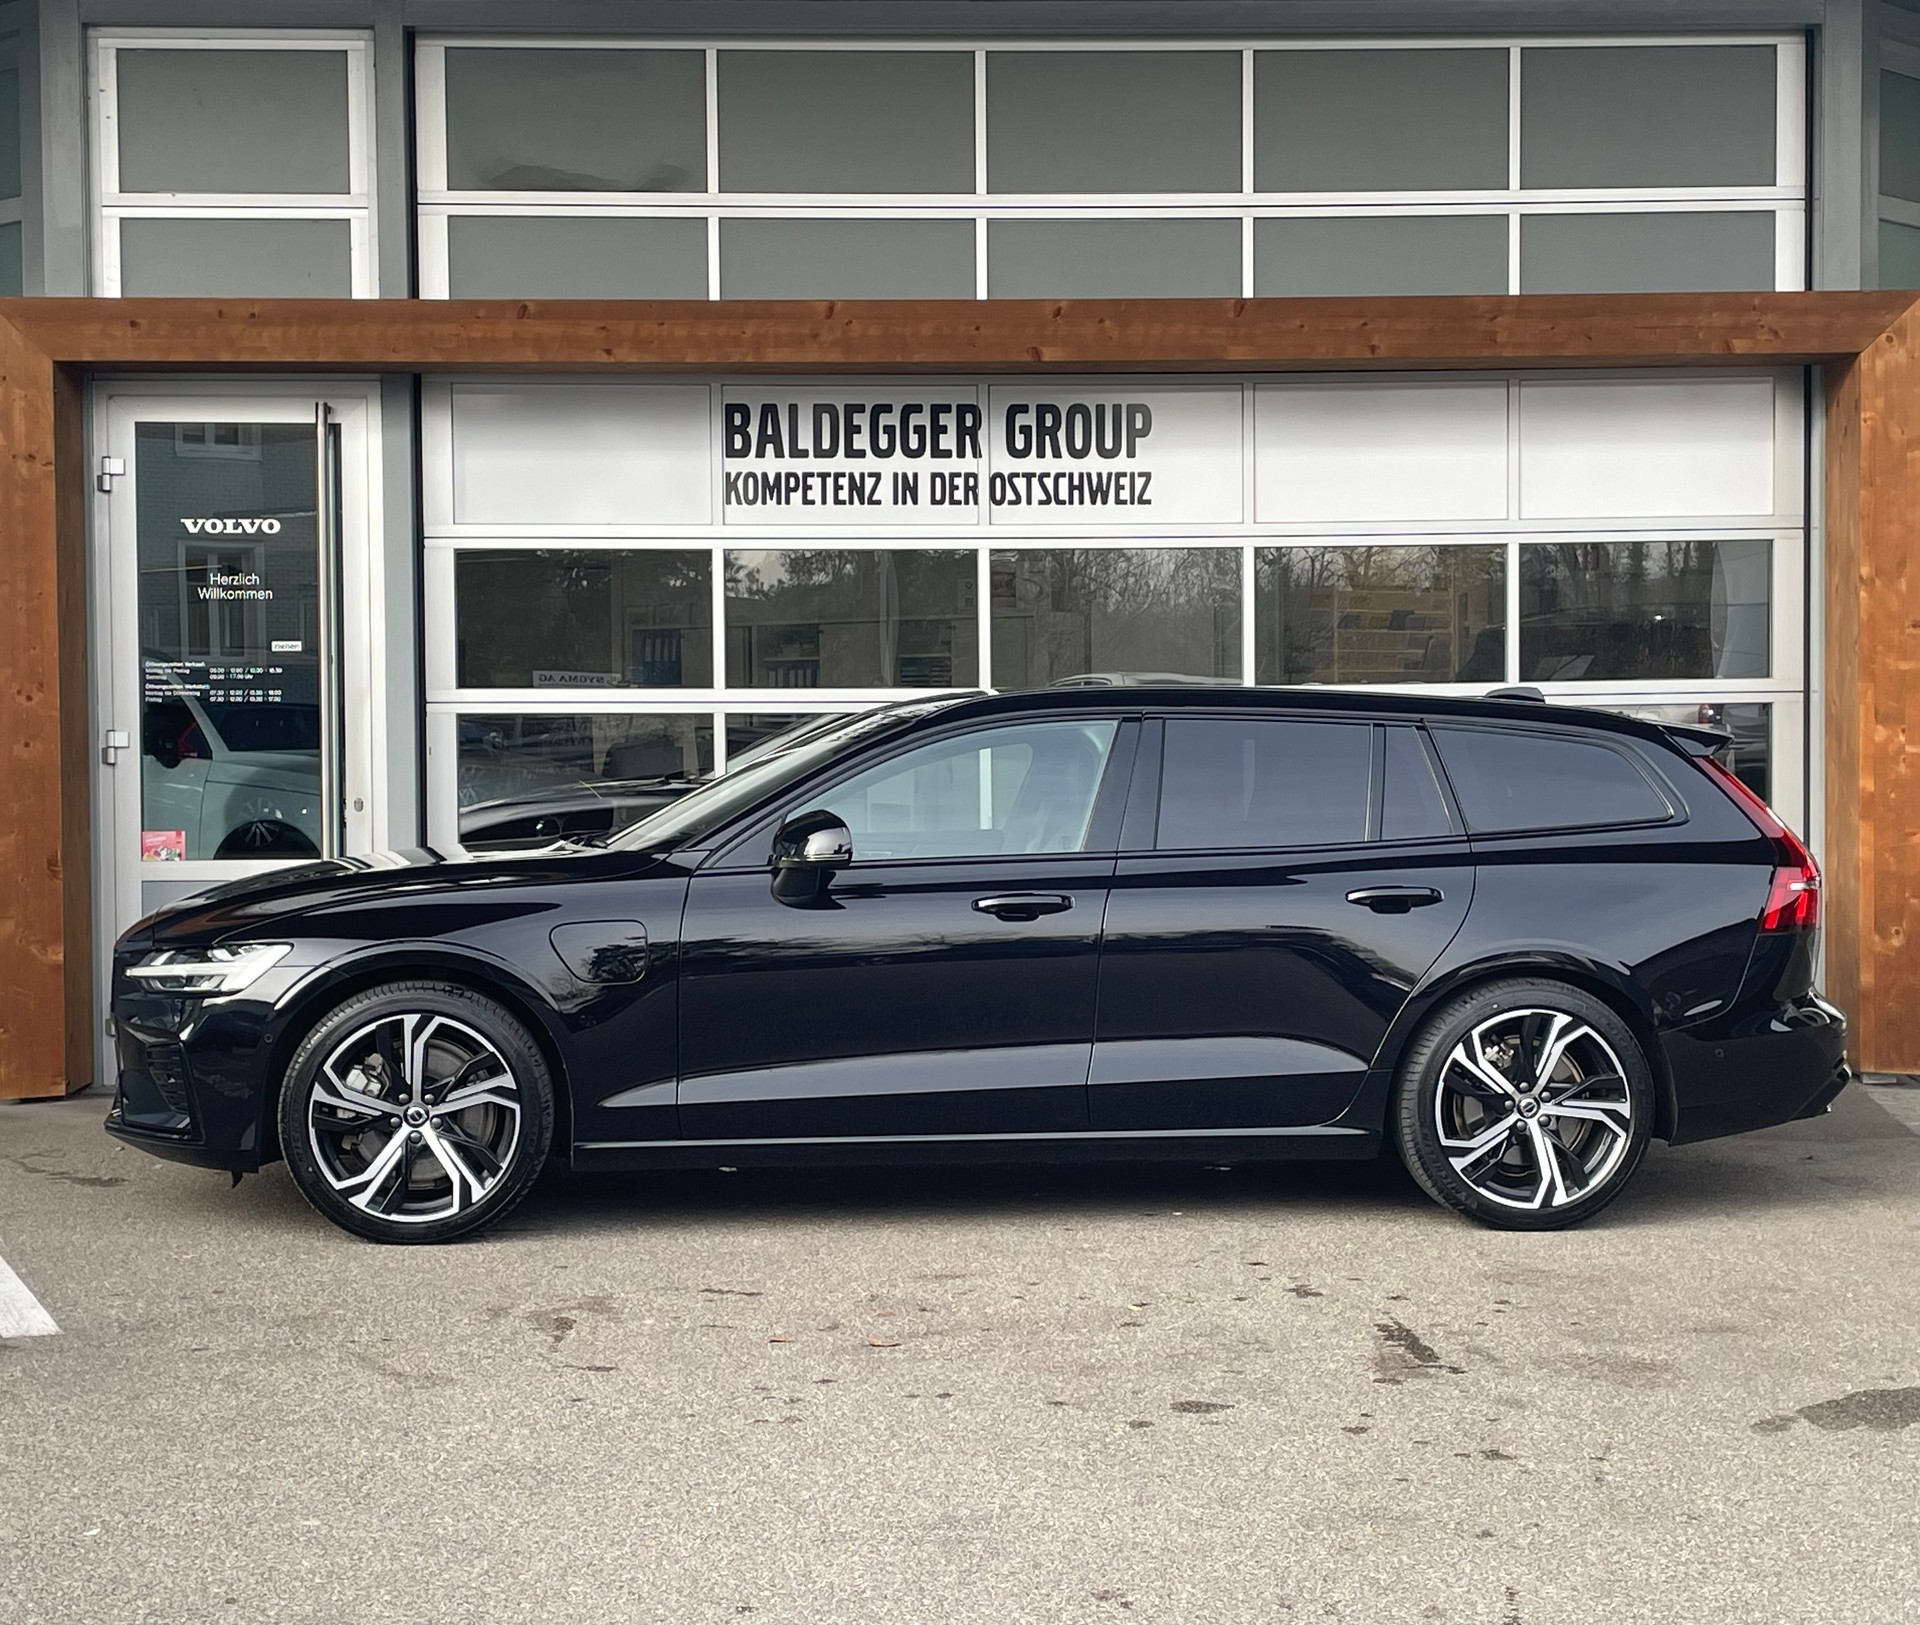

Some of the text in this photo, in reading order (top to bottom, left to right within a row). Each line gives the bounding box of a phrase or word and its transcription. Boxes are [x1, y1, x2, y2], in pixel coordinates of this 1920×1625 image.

[725, 403, 1152, 459] BALDEGGER GROUP
[725, 471, 1152, 505] KOMPETENZ IN DER OSTSCHWEIZ
[180, 518, 281, 534] VOLVO
[209, 573, 260, 585] Herzlich
[197, 587, 273, 600] Willkommen
